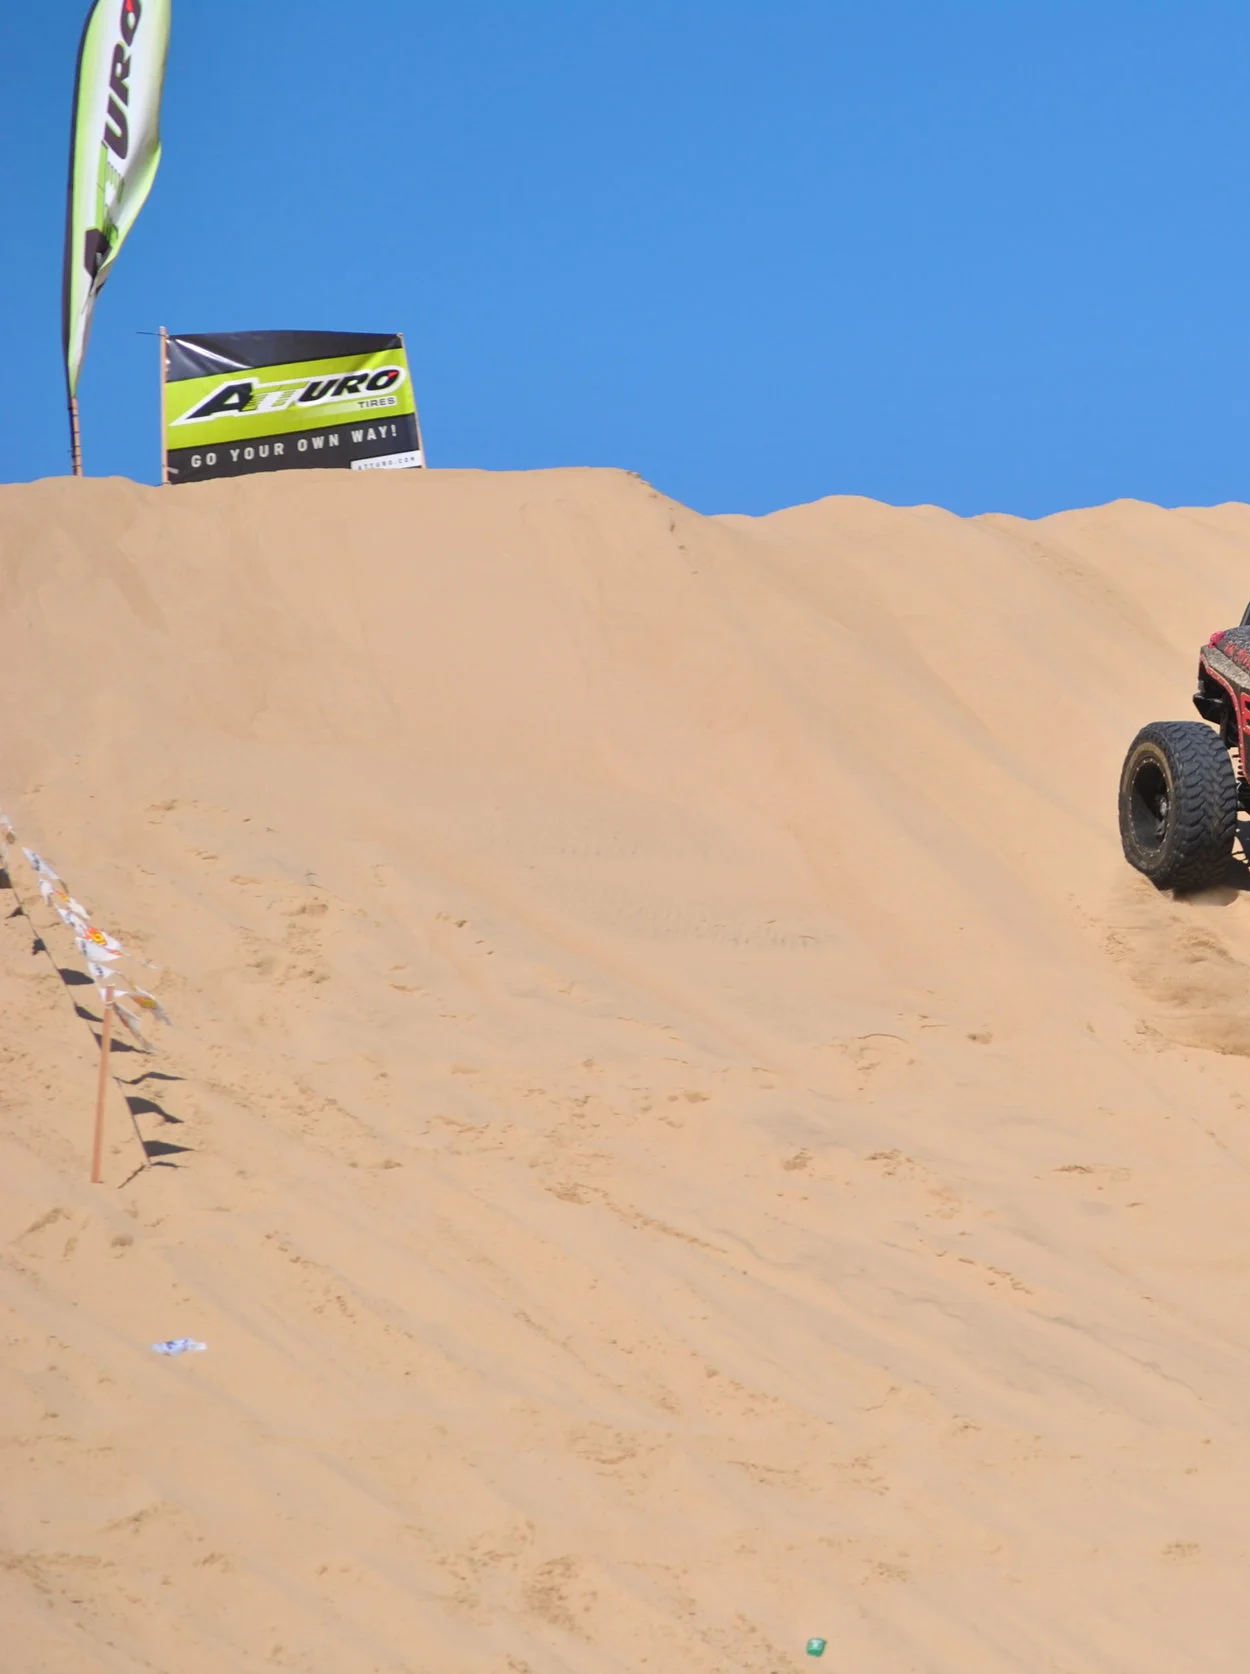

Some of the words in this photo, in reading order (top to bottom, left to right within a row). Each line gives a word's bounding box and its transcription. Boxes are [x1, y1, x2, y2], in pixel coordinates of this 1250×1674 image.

[358, 397, 396, 409] TIRES
[191, 452, 217, 468] GO
[230, 443, 285, 461] YOUR
[297, 434, 340, 452] OWN
[351, 424, 397, 444] WAY!
